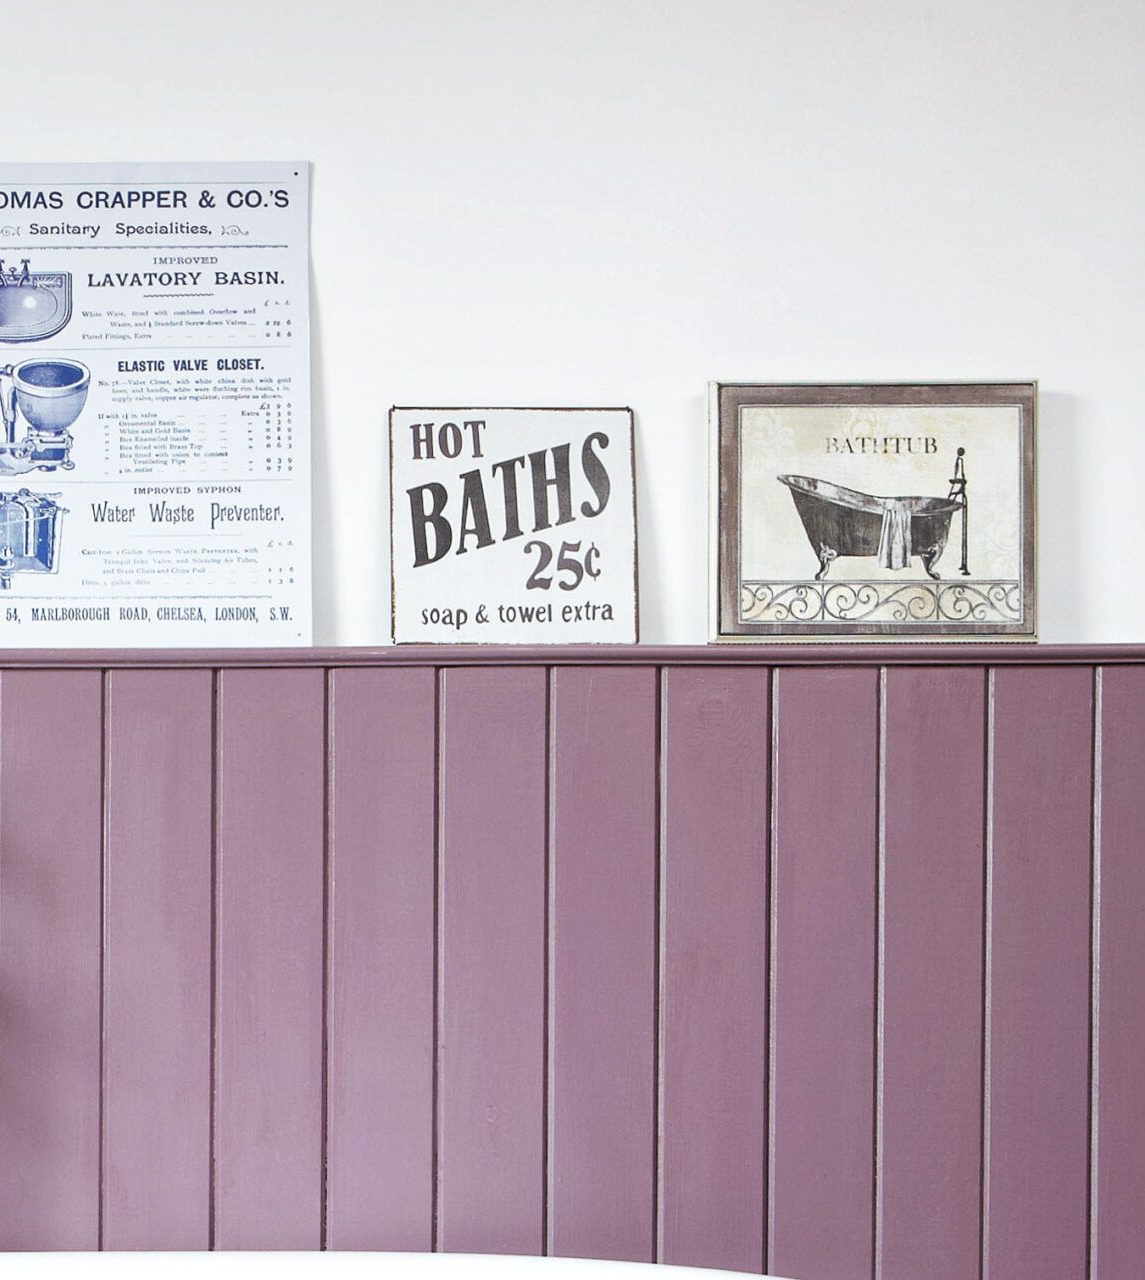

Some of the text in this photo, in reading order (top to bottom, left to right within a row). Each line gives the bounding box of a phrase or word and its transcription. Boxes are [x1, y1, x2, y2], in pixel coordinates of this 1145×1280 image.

[76, 190, 188, 210] CRAPPER
[198, 190, 216, 209] &
[226, 189, 289, 209] CO.'S
[29, 221, 212, 239] Sanitary Specialities,
[153, 256, 218, 265] IMPROVED
[88, 271, 284, 287] LAVATORY BASIN.
[118, 358, 264, 373] ELASTIC VALVE CLOSET.
[409, 421, 486, 460] HOT
[825, 437, 938, 454] BATHTUB
[134, 485, 242, 495] IMPROVED SYPHON
[406, 432, 611, 568] BATHS
[91, 500, 284, 530] Water Waste Preventer.
[523, 540, 601, 591] 25¢
[6, 607, 21, 624] 54,
[31, 607, 110, 622] MARLBOROUGH
[119, 607, 151, 623] ROAD,
[156, 607, 206, 623] CHELSEA,
[215, 606, 259, 624] LONDON,
[421, 601, 615, 630] soap & towel extra
